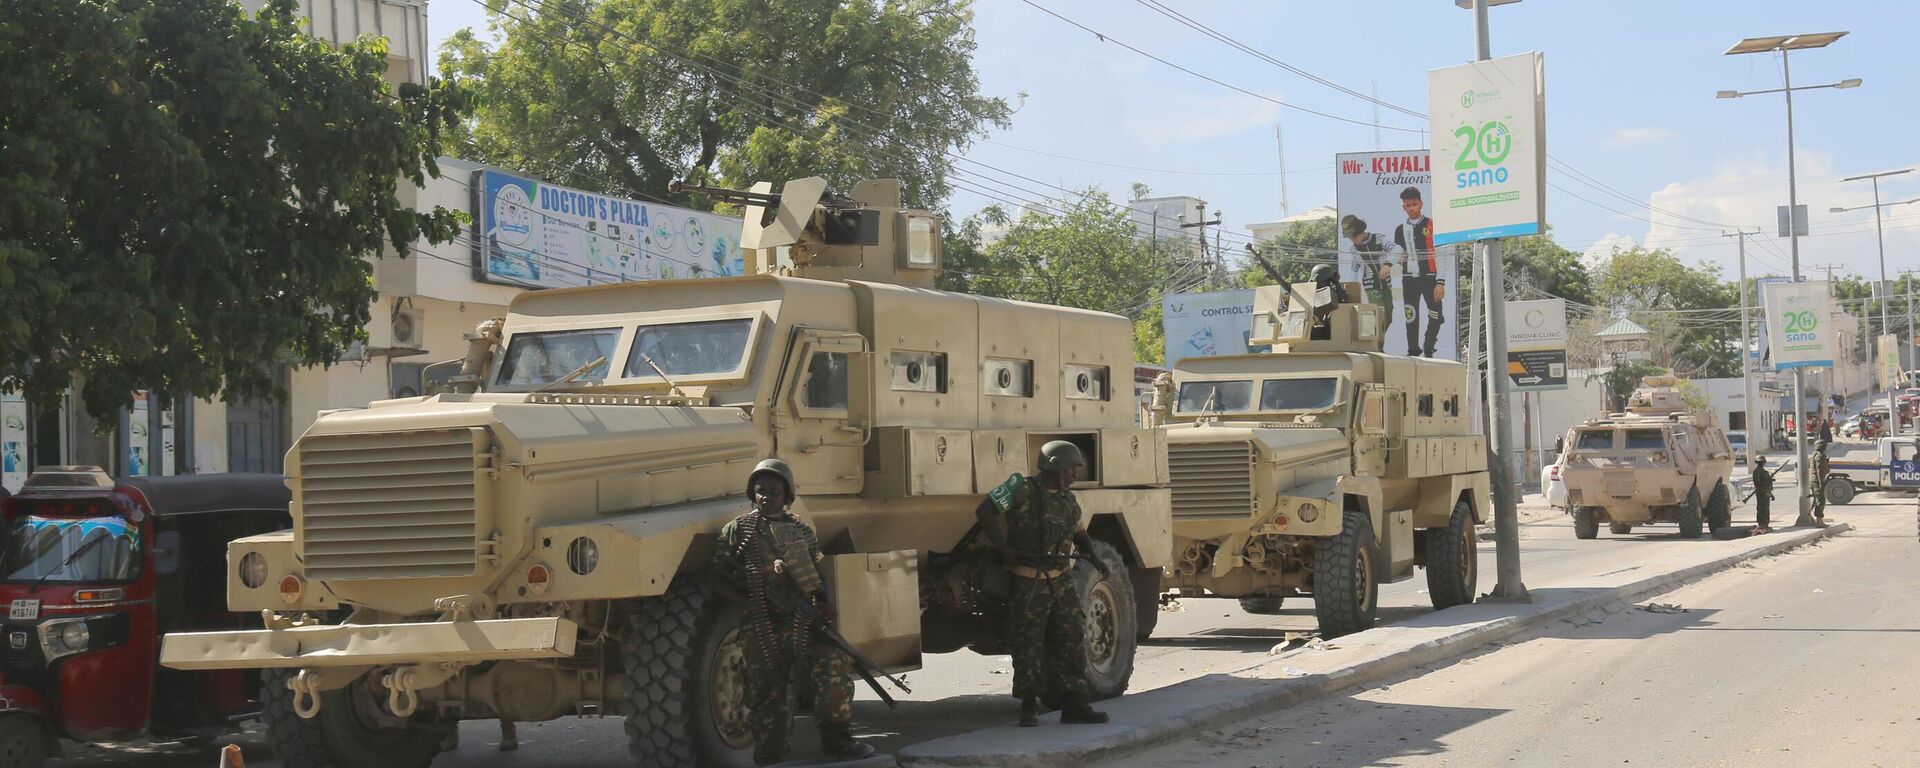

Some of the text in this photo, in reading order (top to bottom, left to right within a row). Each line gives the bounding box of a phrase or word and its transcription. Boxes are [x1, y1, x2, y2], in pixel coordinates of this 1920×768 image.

[1343, 160, 1369, 174] Mr.
[1375, 171, 1425, 185] Fashion
[540, 186, 607, 220] DOCTOR'S
[611, 200, 649, 227] PLAZA
[1201, 306, 1243, 317] CONTROL
